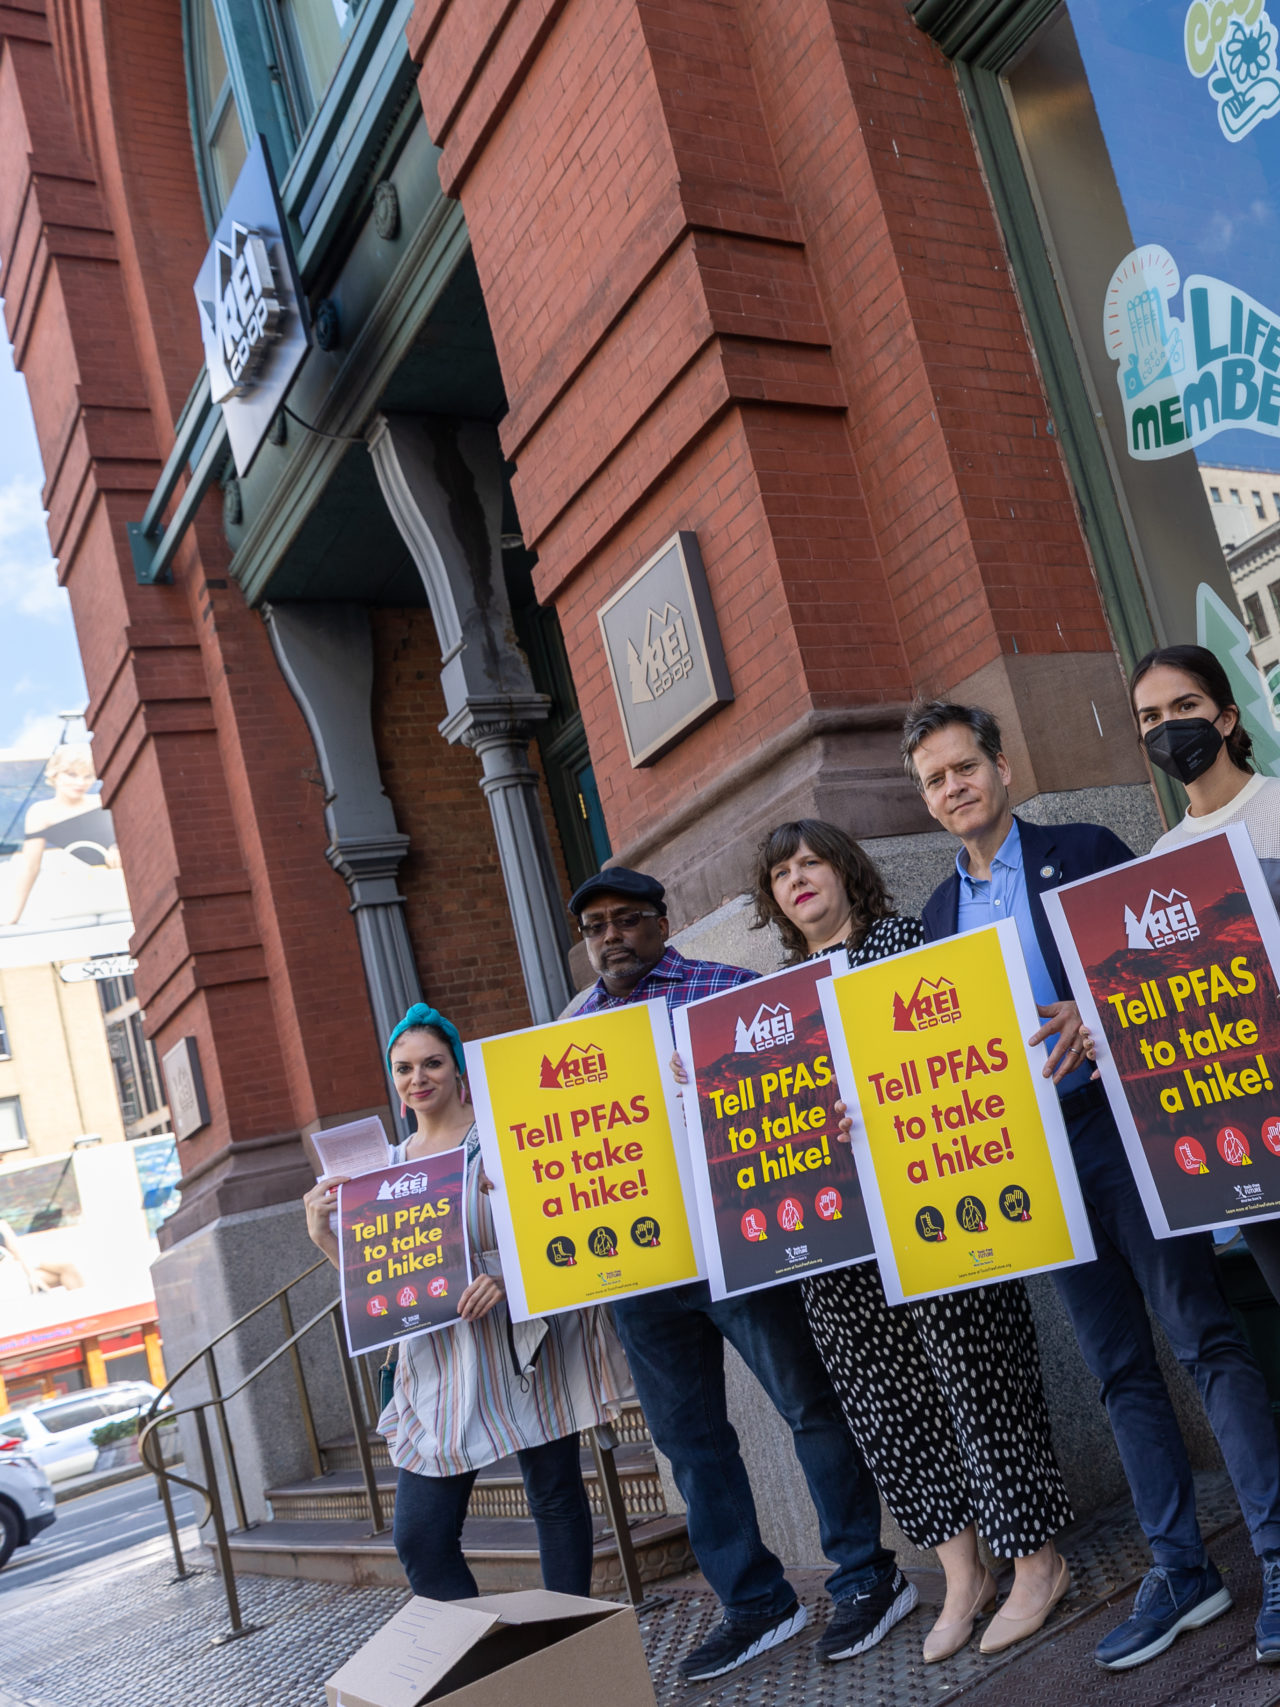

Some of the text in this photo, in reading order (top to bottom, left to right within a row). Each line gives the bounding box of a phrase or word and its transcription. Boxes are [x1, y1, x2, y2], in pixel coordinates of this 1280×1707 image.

[222, 239, 263, 360] REI
[650, 615, 691, 682] REI
[1149, 901, 1198, 938] REI
[916, 988, 960, 1020] REI
[1108, 956, 1257, 1030] Tell PFAS
[754, 1012, 794, 1042] REI
[1140, 1013, 1259, 1070] to take
[563, 1053, 607, 1079] REI
[709, 1055, 832, 1120] Tell PFAS
[868, 1037, 1009, 1105] Tell PFAS
[1159, 1054, 1274, 1114] a hike!
[510, 1095, 650, 1151] Tell PFAS
[728, 1102, 826, 1153] to take
[894, 1089, 1006, 1144] to take
[532, 1138, 643, 1183] to take
[736, 1135, 832, 1190] a hike!
[907, 1127, 1015, 1184] a hike!
[399, 1176, 428, 1194] REI
[542, 1169, 649, 1218] a hike!
[352, 1198, 450, 1242] Tell PFAS
[364, 1226, 442, 1262] to take
[367, 1246, 444, 1284] a hike!
